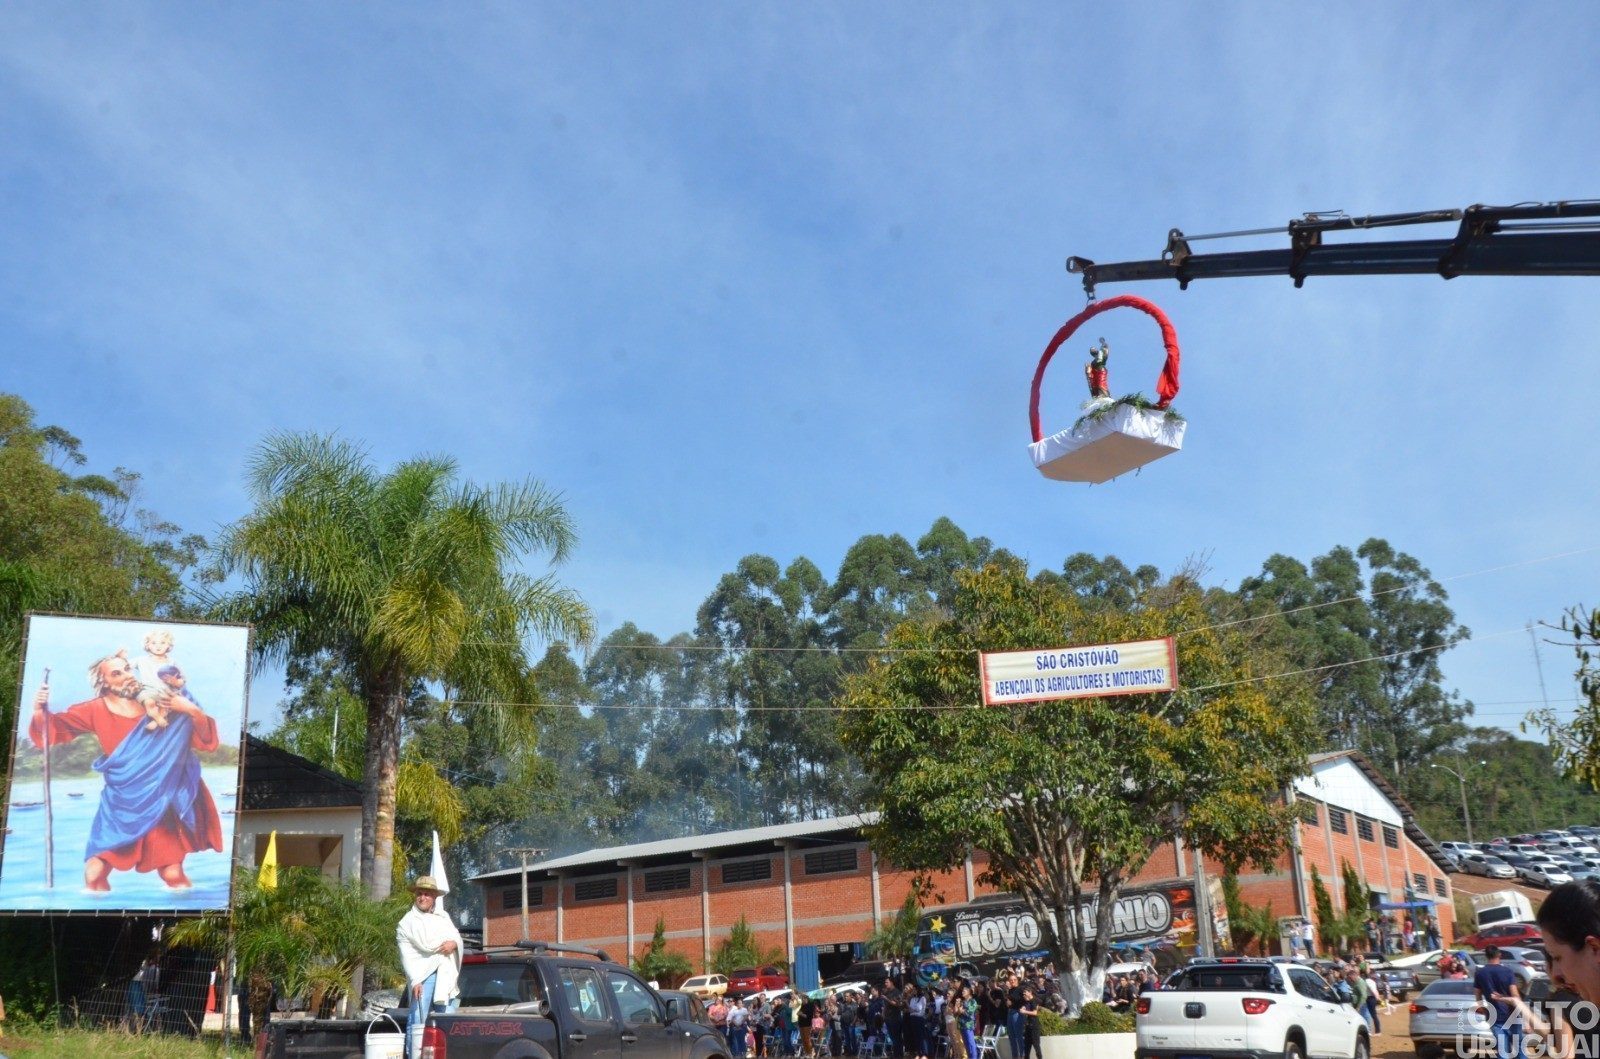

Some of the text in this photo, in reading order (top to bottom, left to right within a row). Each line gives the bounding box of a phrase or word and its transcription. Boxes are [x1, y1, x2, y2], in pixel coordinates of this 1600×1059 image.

[1036, 647, 1119, 671] SÃO CRISTÓVÃO
[995, 668, 1165, 699] ABENÇOAI OS AGRICULTORES E MOTORISTAS!
[957, 913, 1040, 956] NOVO
[449, 1020, 524, 1036] ATTACK
